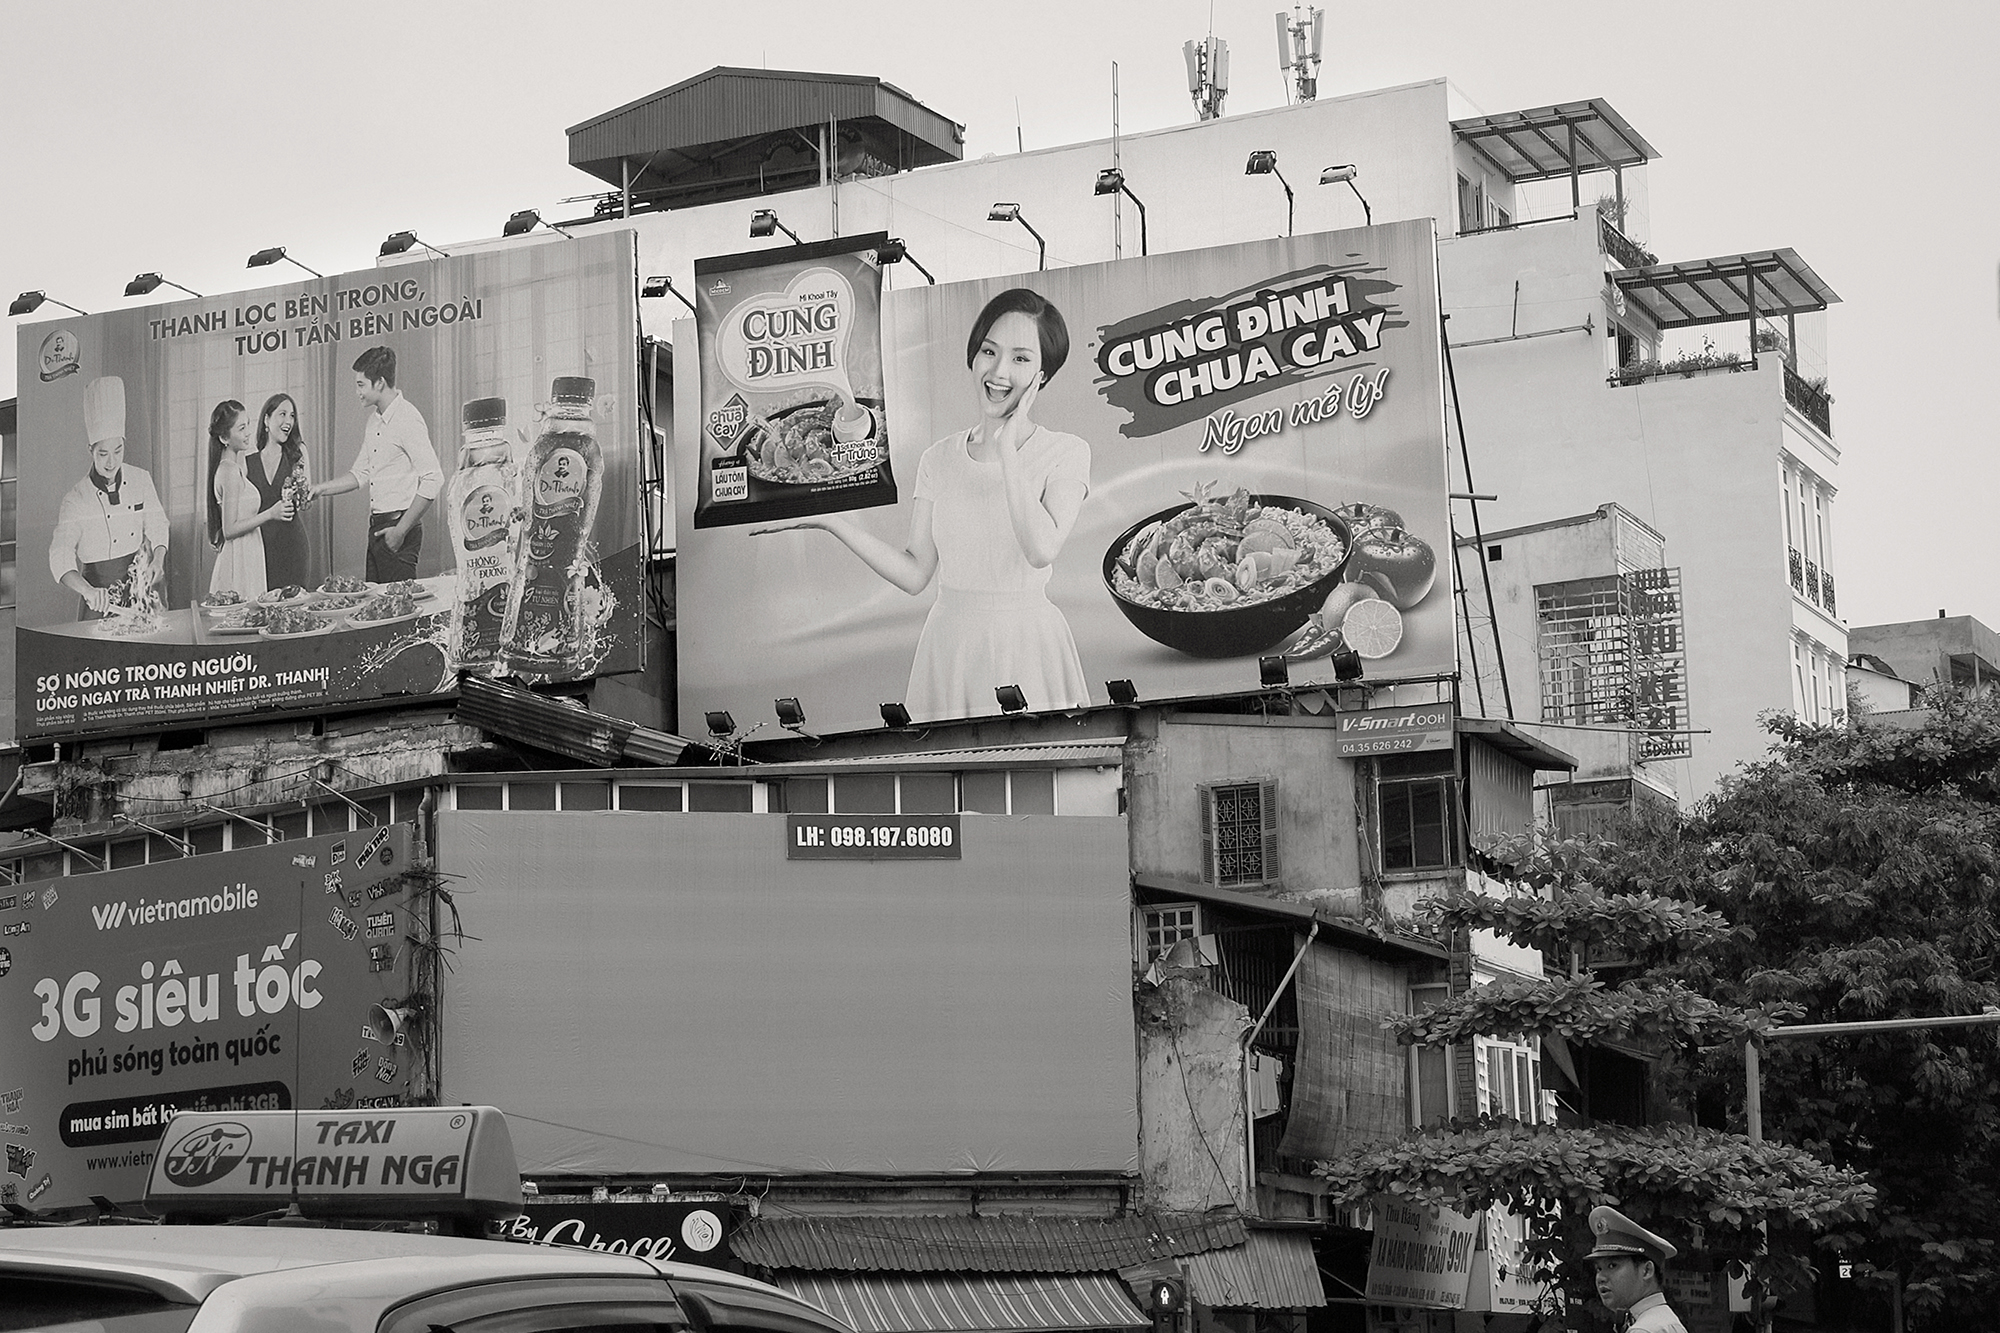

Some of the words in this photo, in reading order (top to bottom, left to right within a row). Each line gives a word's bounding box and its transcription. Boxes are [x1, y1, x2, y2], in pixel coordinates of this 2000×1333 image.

[149, 310, 227, 340] THANH
[235, 301, 277, 330] LỌC
[284, 292, 328, 320] BÊN
[336, 279, 426, 312] TRONG,
[234, 328, 288, 356] TƯƠI
[295, 316, 341, 347] TẮN
[349, 311, 394, 339] BÊN
[402, 295, 482, 331] NGOÀI
[742, 302, 838, 341] CUNG
[1107, 316, 1228, 378] CUNG
[1236, 280, 1350, 343] ĐÌNH
[748, 340, 836, 379] ĐÌNH
[1153, 345, 1282, 406] CHUA
[1290, 311, 1387, 369] CAY
[1199, 408, 1284, 456] Ngon
[1289, 386, 1343, 430] mê
[1345, 366, 1392, 422] ly!
[466, 555, 497, 569] KHÔNG
[36, 672, 61, 694] SỢ
[65, 666, 121, 690] NÓNG
[125, 661, 187, 682] TRONG
[192, 651, 258, 677] NGƯỜI,
[82, 688, 122, 707] NGAY
[125, 684, 151, 702] TRÀ
[154, 682, 202, 700] THANH
[205, 676, 246, 695] NHIỆT
[249, 674, 272, 691] DR.
[275, 666, 330, 686] THANH!
[1342, 713, 1416, 732] V-Smart
[1416, 713, 1446, 726] OOH
[1342, 742, 1371, 754] 04.35
[1372, 740, 1392, 751] 626
[1393, 739, 1413, 749] 242
[796, 826, 825, 847] LH:
[830, 826, 953, 847] 098.197.6080
[128, 882, 259, 926] vietnamobile
[366, 911, 393, 928] TUYÊN
[365, 926, 394, 939] QUANG
[30, 970, 102, 1043] 3G
[113, 959, 220, 1034] siêu
[233, 932, 324, 1019] tốc
[67, 1044, 107, 1086] phủ
[112, 1044, 164, 1077] sóng
[169, 1035, 219, 1067] toàn
[224, 1023, 281, 1067] quốc
[70, 1115, 102, 1134] mua
[104, 1109, 130, 1131] sim
[132, 1103, 158, 1128] bất
[316, 1119, 397, 1147] TAXI
[245, 1154, 370, 1189] THANH
[380, 1154, 460, 1189] NGA
[511, 1215, 539, 1245] By
[1447, 1230, 1473, 1274] 99K
